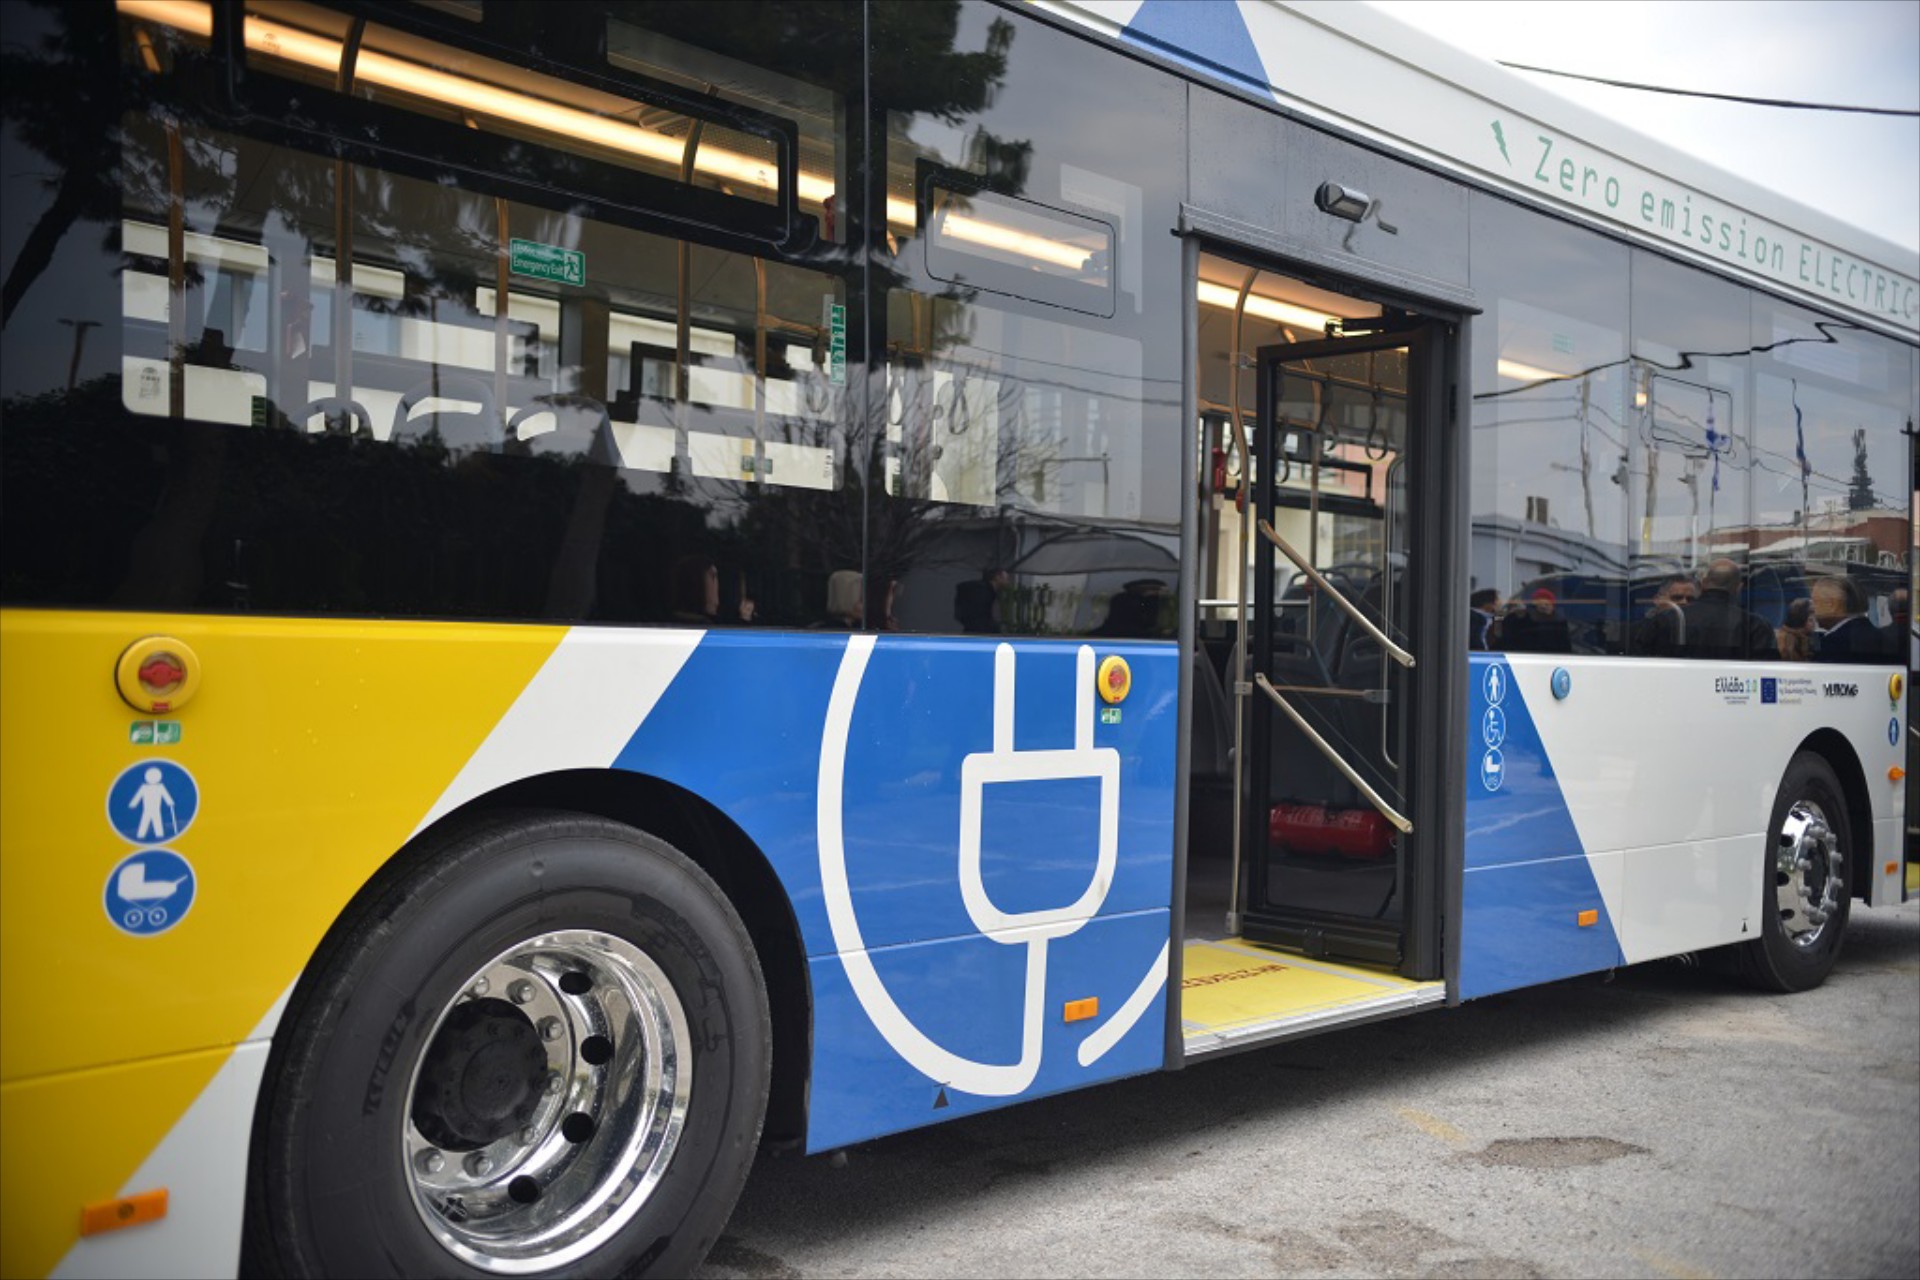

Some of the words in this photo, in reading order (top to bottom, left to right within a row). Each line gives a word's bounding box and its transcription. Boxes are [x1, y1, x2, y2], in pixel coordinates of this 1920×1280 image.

[1535, 136, 1619, 208] Zero
[1640, 190, 1784, 272] emission
[1799, 243, 1914, 319] ELECTRIC
[513, 256, 551, 275] Emergency
[551, 262, 564, 275] Exit
[1823, 683, 1859, 697] YUTONG
